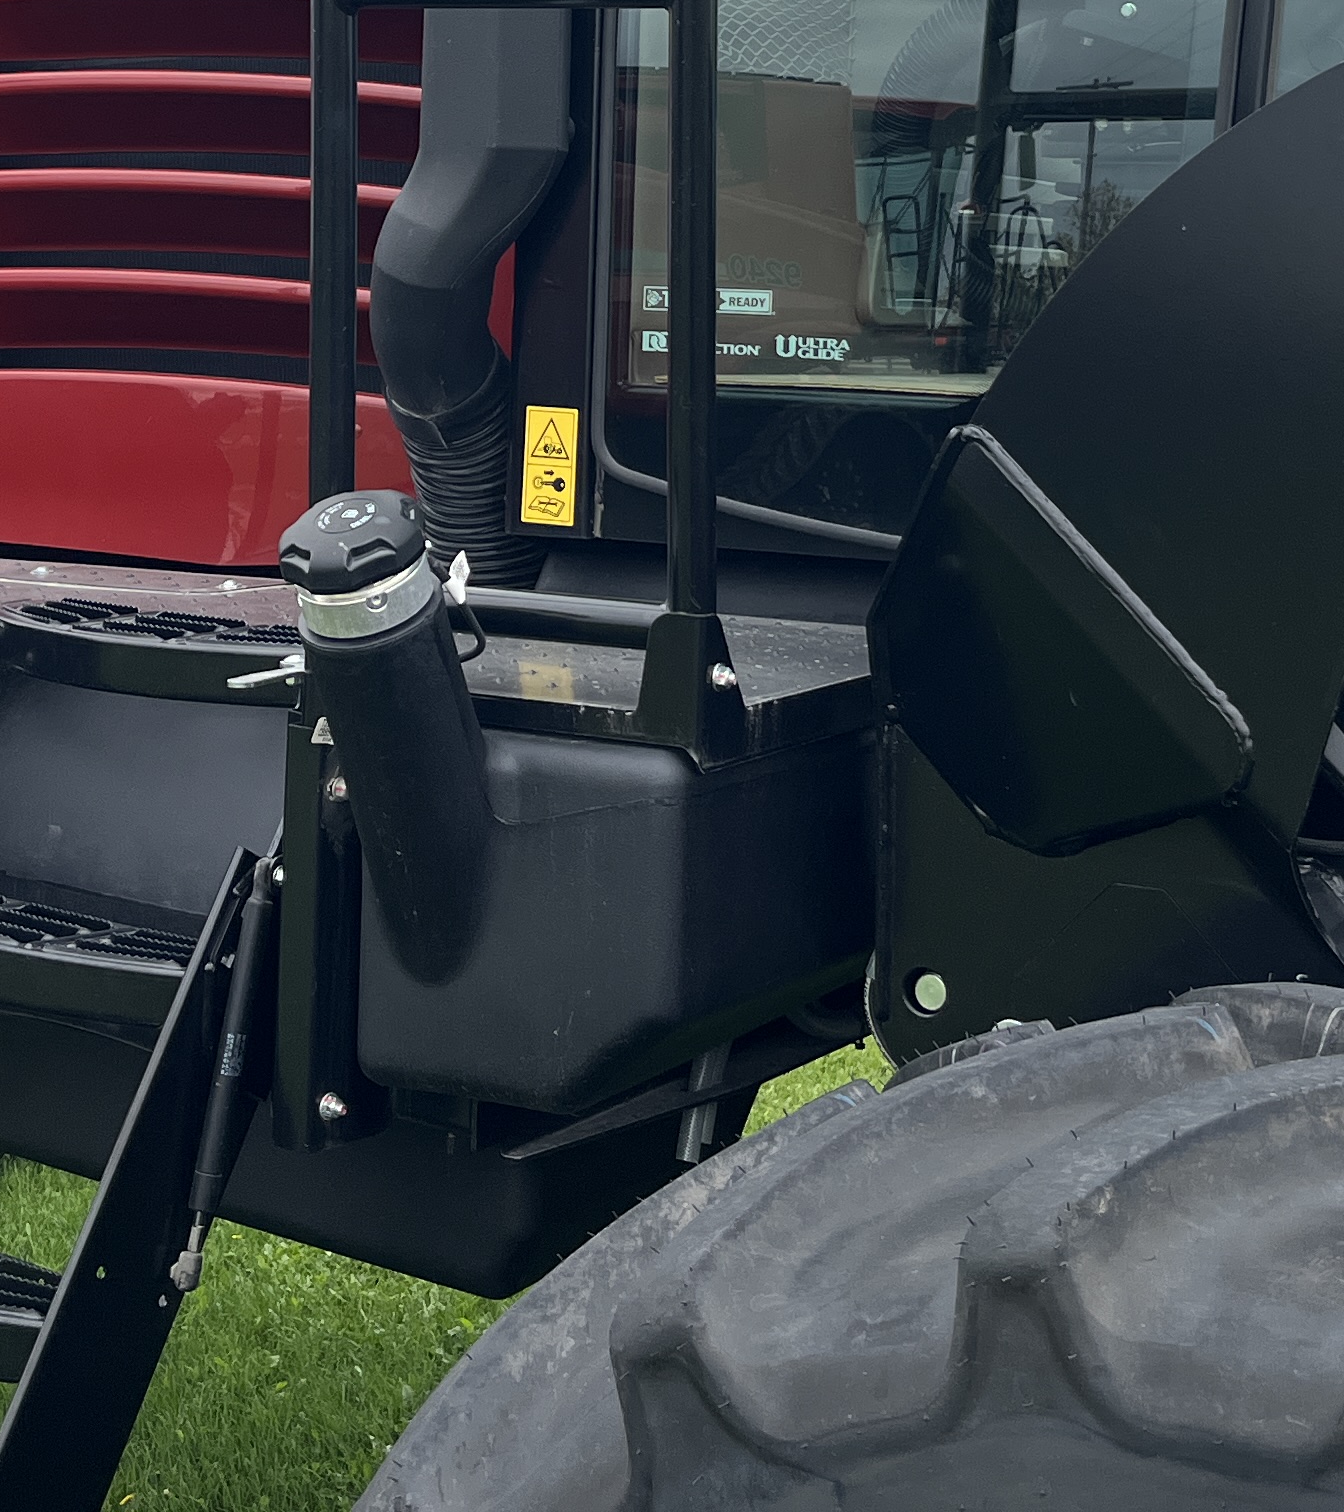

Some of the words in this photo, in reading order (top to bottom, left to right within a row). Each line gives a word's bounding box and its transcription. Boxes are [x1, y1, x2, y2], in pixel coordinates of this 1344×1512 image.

[729, 296, 766, 308] READY
[798, 336, 850, 351] ULTRA
[797, 348, 845, 361] GLIDE
